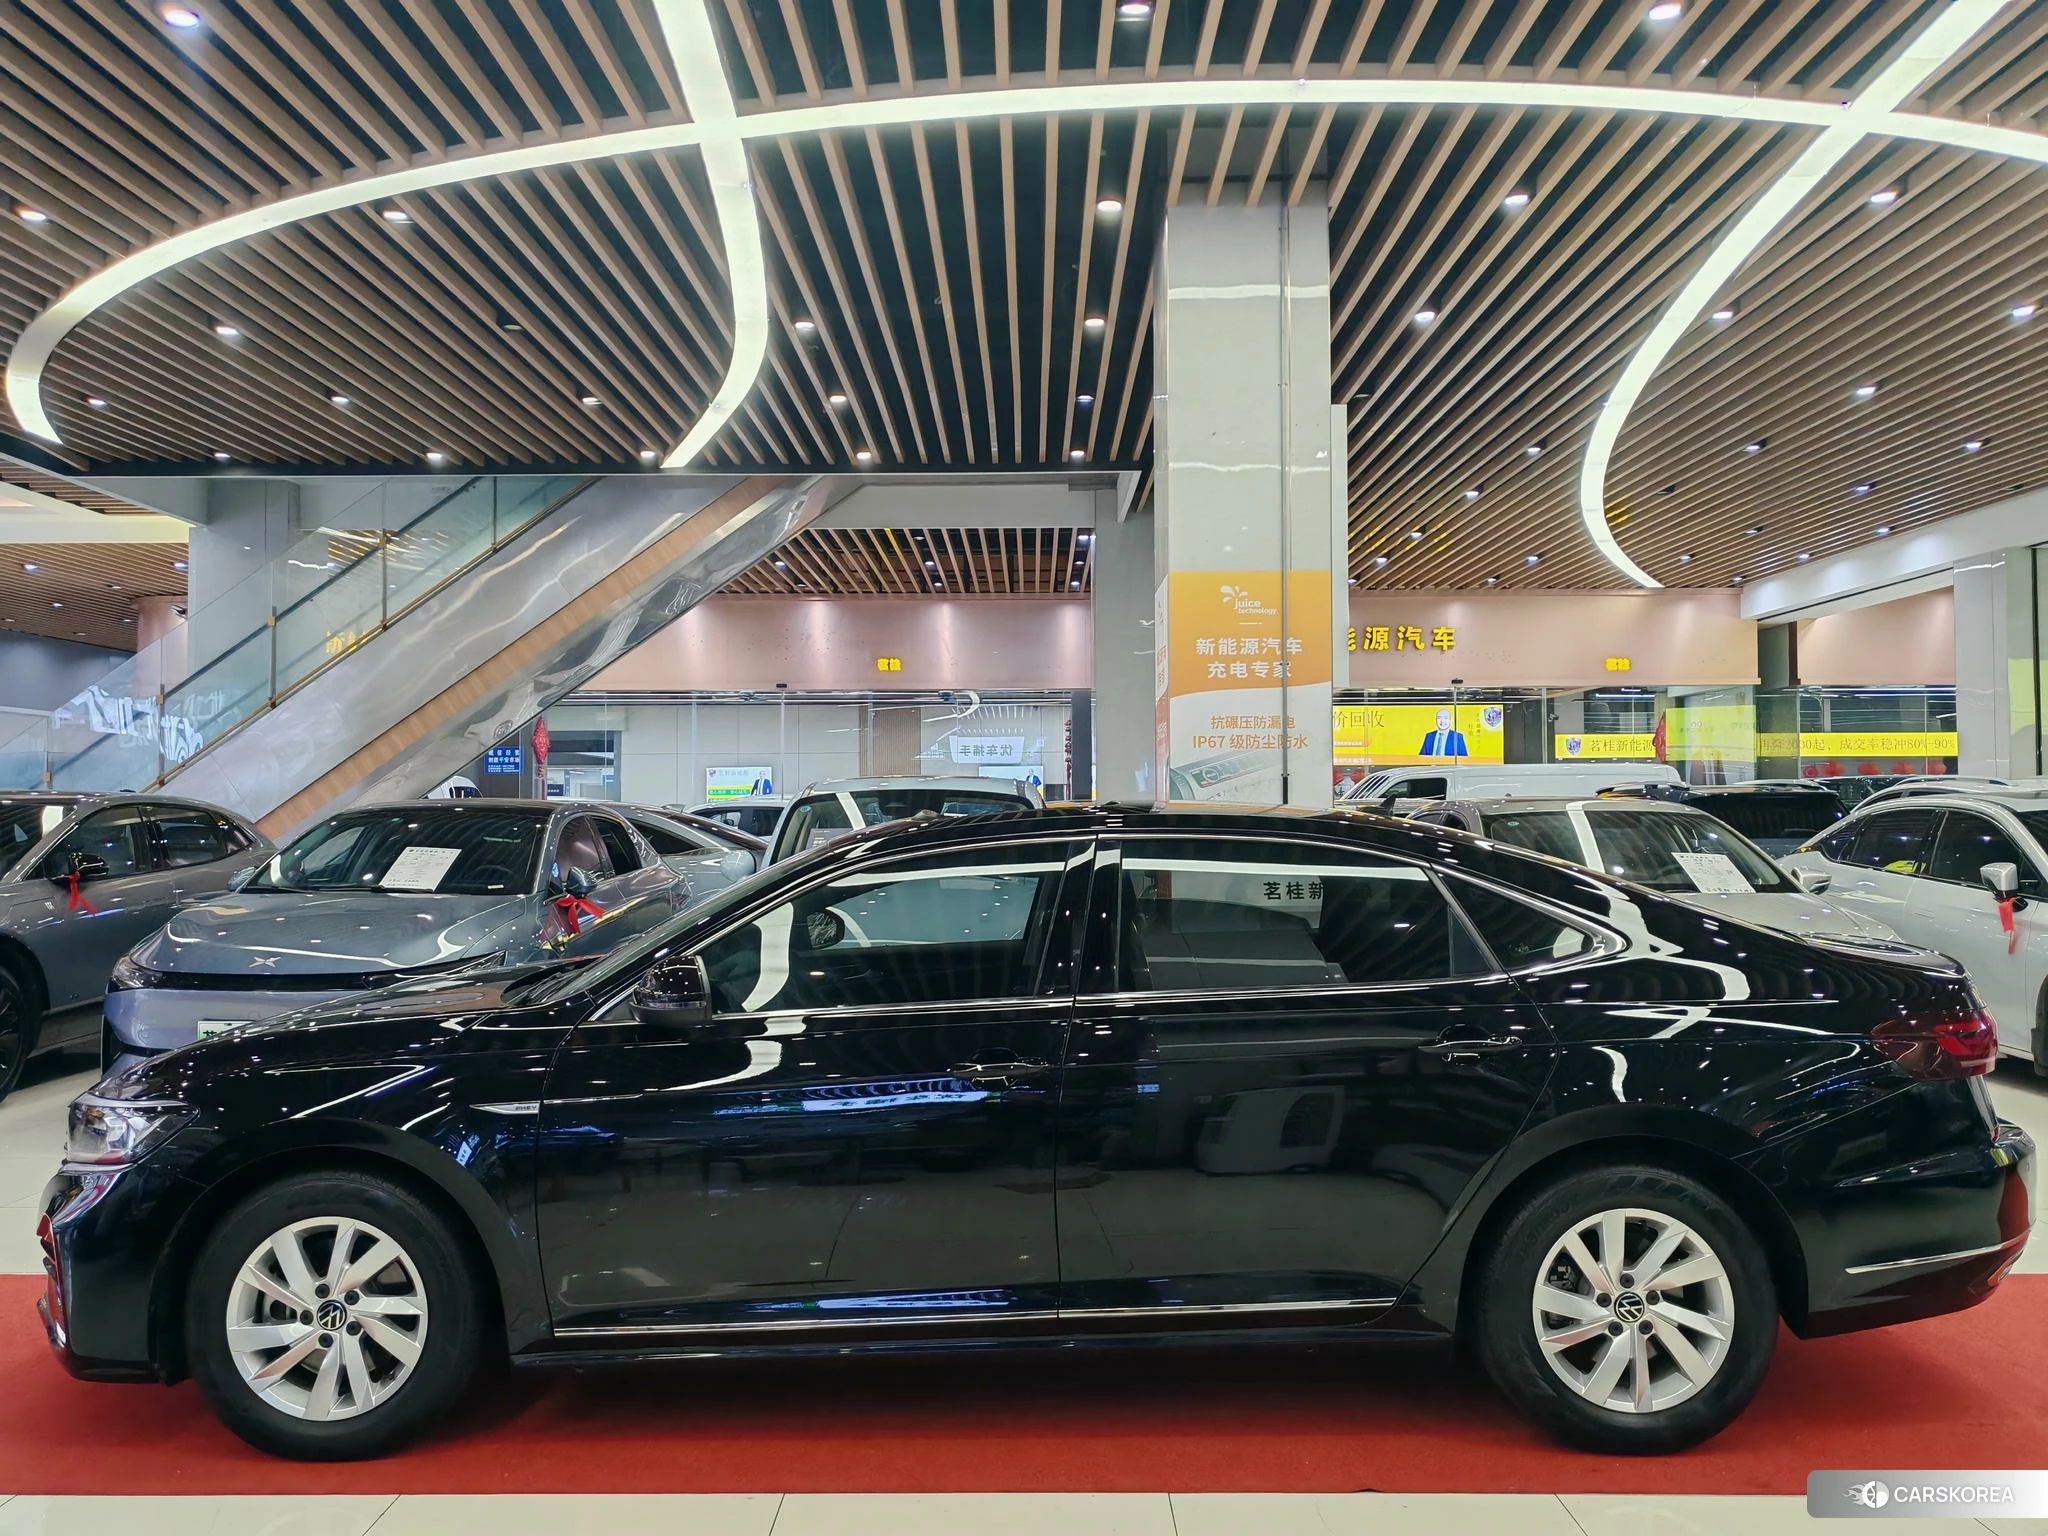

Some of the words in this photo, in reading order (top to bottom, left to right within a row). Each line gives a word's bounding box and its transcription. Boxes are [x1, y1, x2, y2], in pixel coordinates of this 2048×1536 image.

[1233, 599, 1261, 610] juice
[1238, 607, 1277, 615] technology
[1195, 637, 1303, 656] 新能源汽车
[1207, 660, 1292, 679] 充电专家
[1210, 715, 1296, 730] 抗碾压防漏电
[1192, 735, 1226, 749] IP67
[1229, 734, 1309, 750] 级防尘防水
[1263, 881, 1325, 900] 茗桂新
